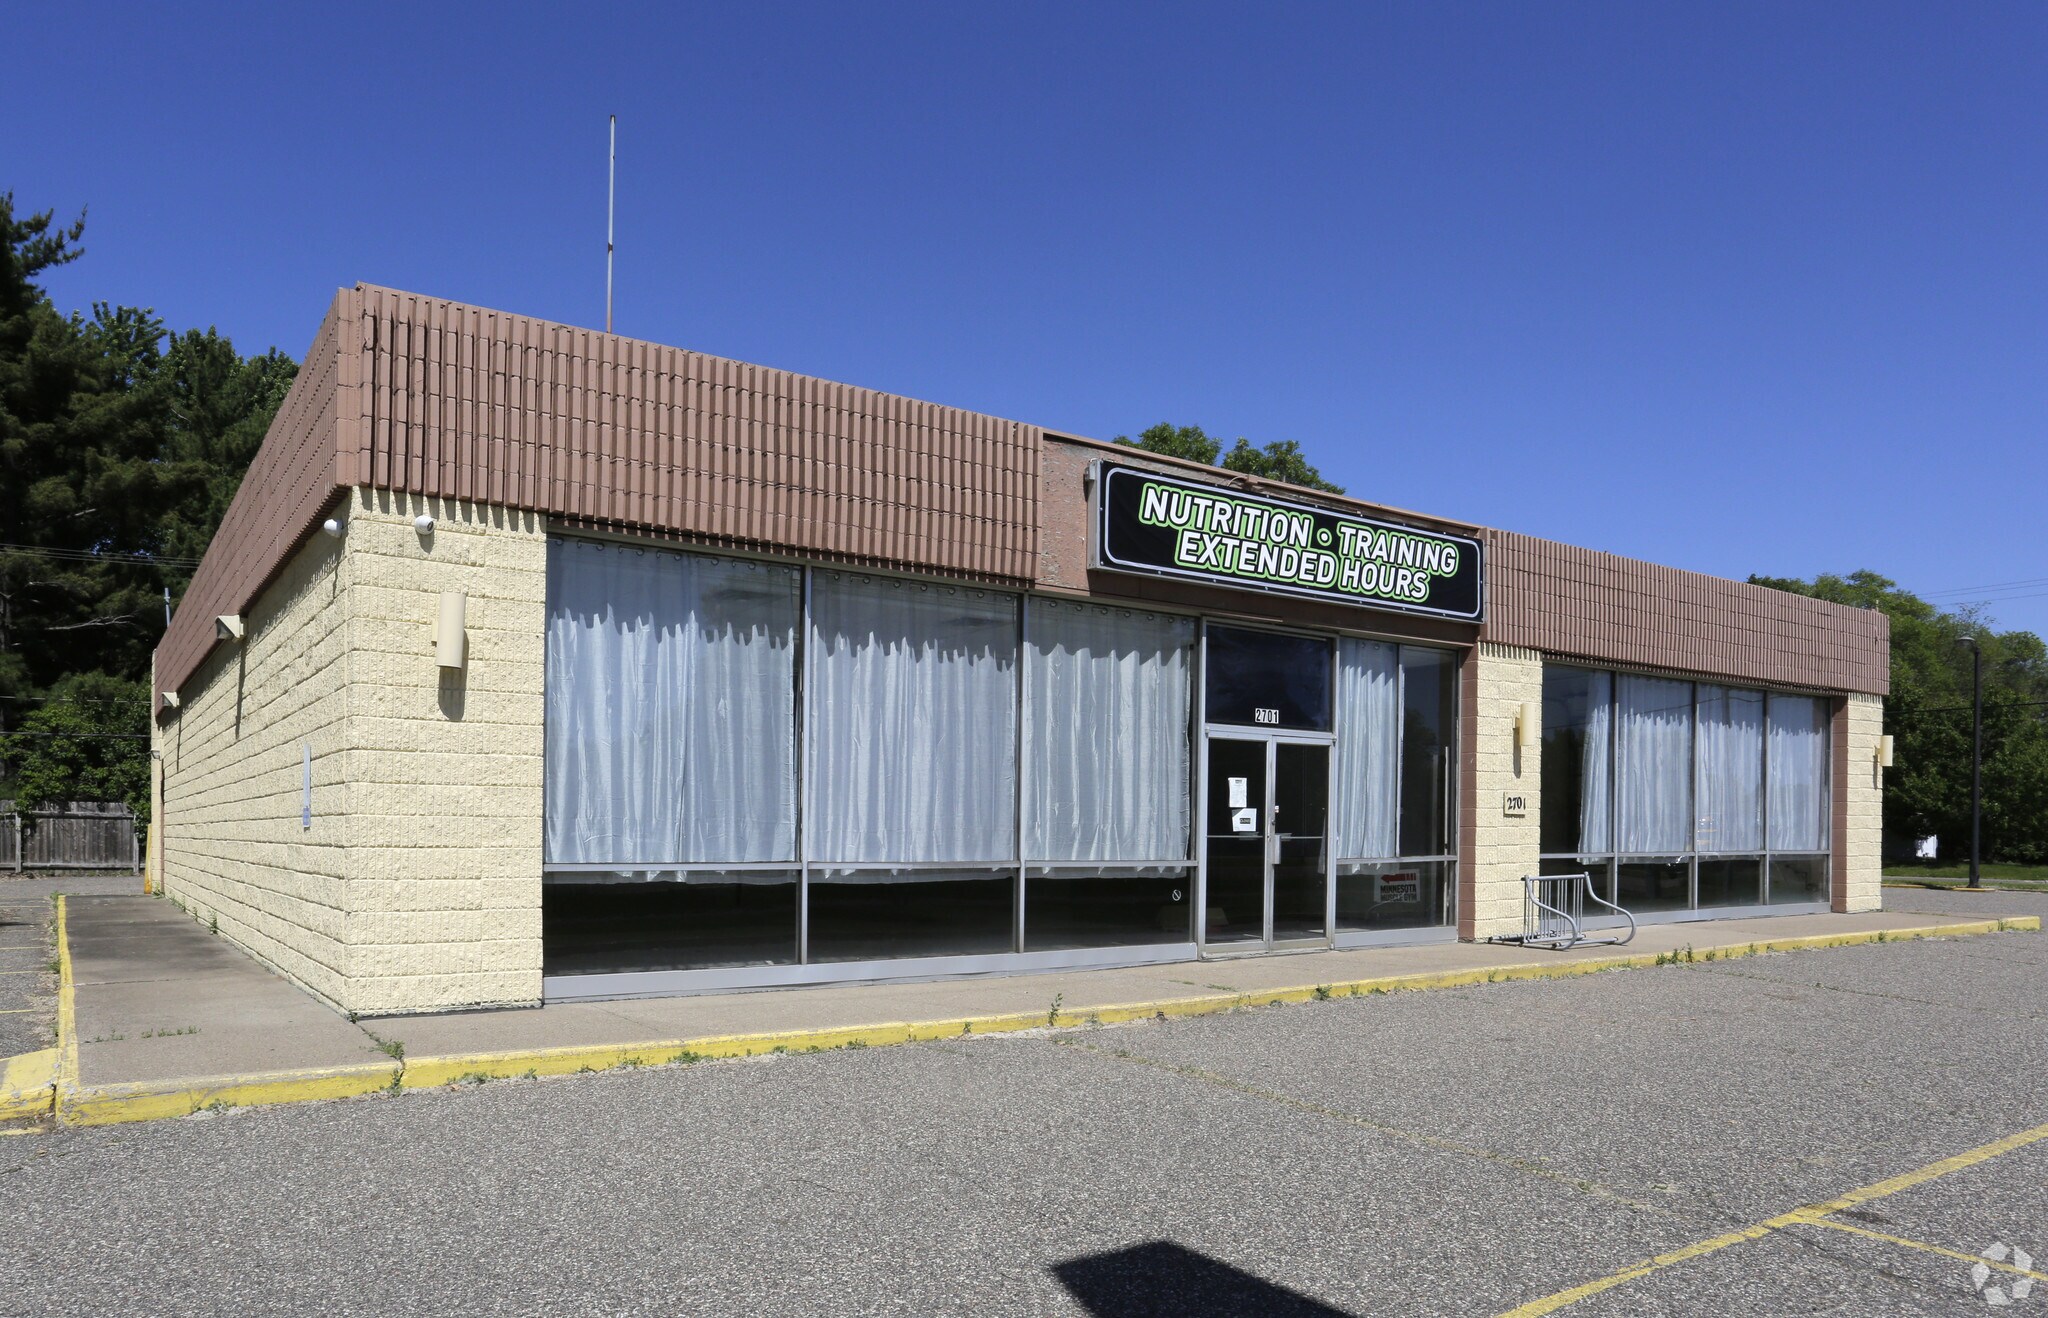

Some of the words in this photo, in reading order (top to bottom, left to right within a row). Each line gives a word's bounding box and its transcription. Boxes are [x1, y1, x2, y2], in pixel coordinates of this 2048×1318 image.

[1142, 487, 1311, 548] NUTRITION
[1339, 526, 1457, 572] TRAINING
[1178, 531, 1336, 584] EXTENDED
[1341, 558, 1428, 598] HOURS
[1256, 709, 1278, 723] 2701
[1507, 796, 1526, 810] 2701
[1380, 884, 1417, 894] MINNESOTA
